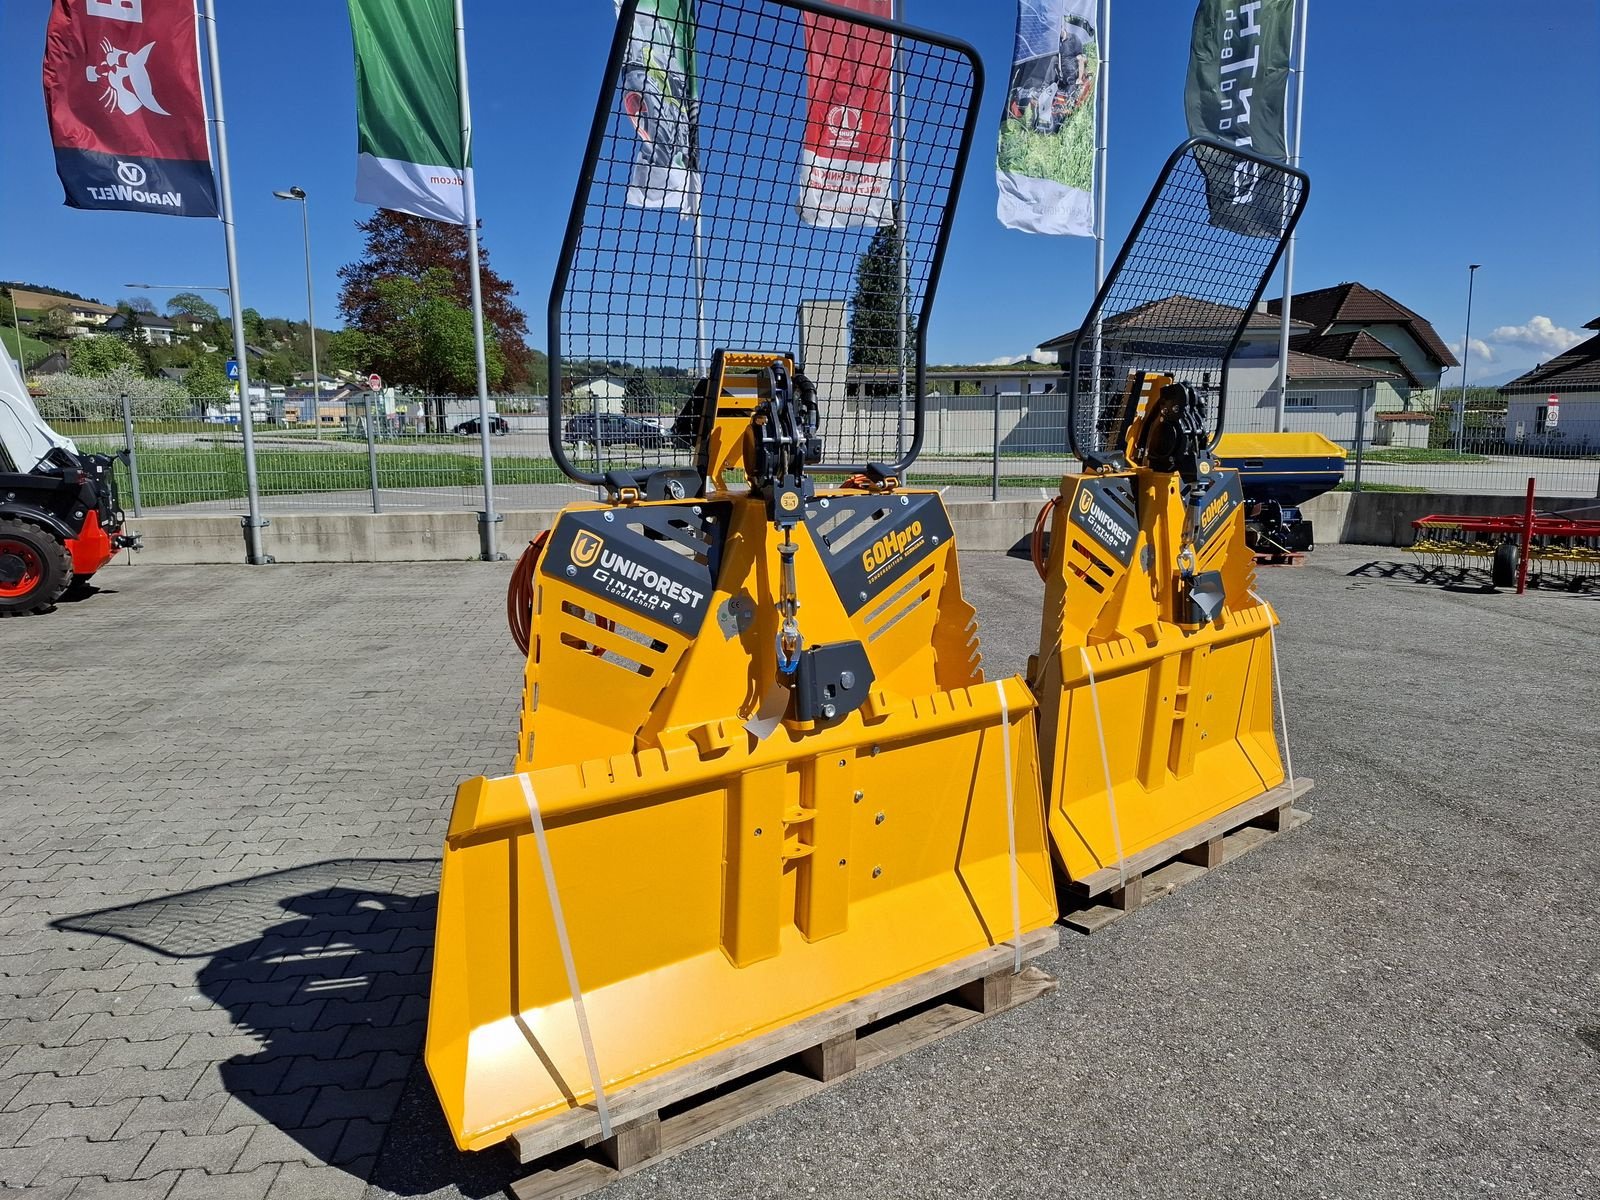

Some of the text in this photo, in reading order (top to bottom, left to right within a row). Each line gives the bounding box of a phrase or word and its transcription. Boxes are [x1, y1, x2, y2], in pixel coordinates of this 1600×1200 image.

[862, 520, 922, 573] 60Hpro
[1090, 502, 1132, 546] UNIFOREST
[592, 568, 672, 611] GINTHÖR
[600, 549, 704, 609] UNIFOREST
